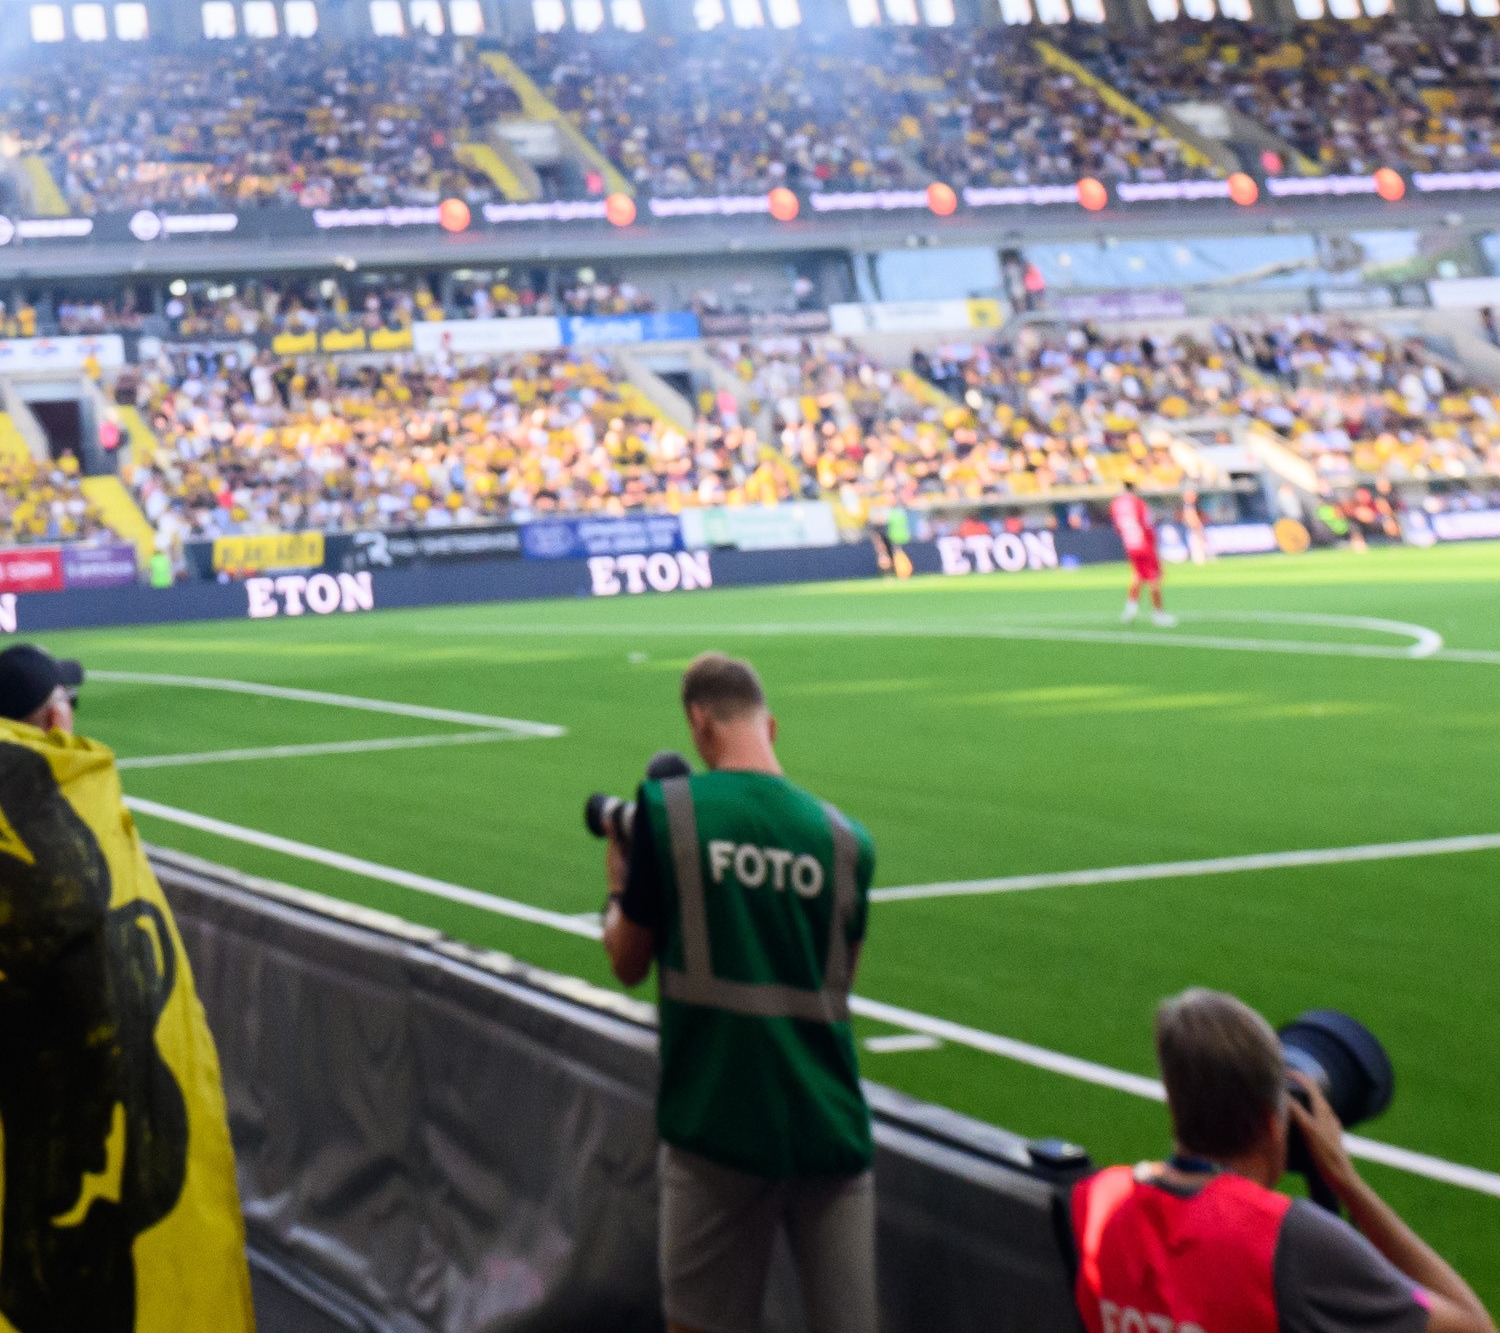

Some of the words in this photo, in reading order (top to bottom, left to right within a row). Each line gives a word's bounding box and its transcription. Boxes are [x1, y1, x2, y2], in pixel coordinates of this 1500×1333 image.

[587, 550, 713, 597] ETON
[936, 530, 1060, 576] ETON
[245, 571, 376, 618] ETON
[706, 838, 826, 900] FOTO
